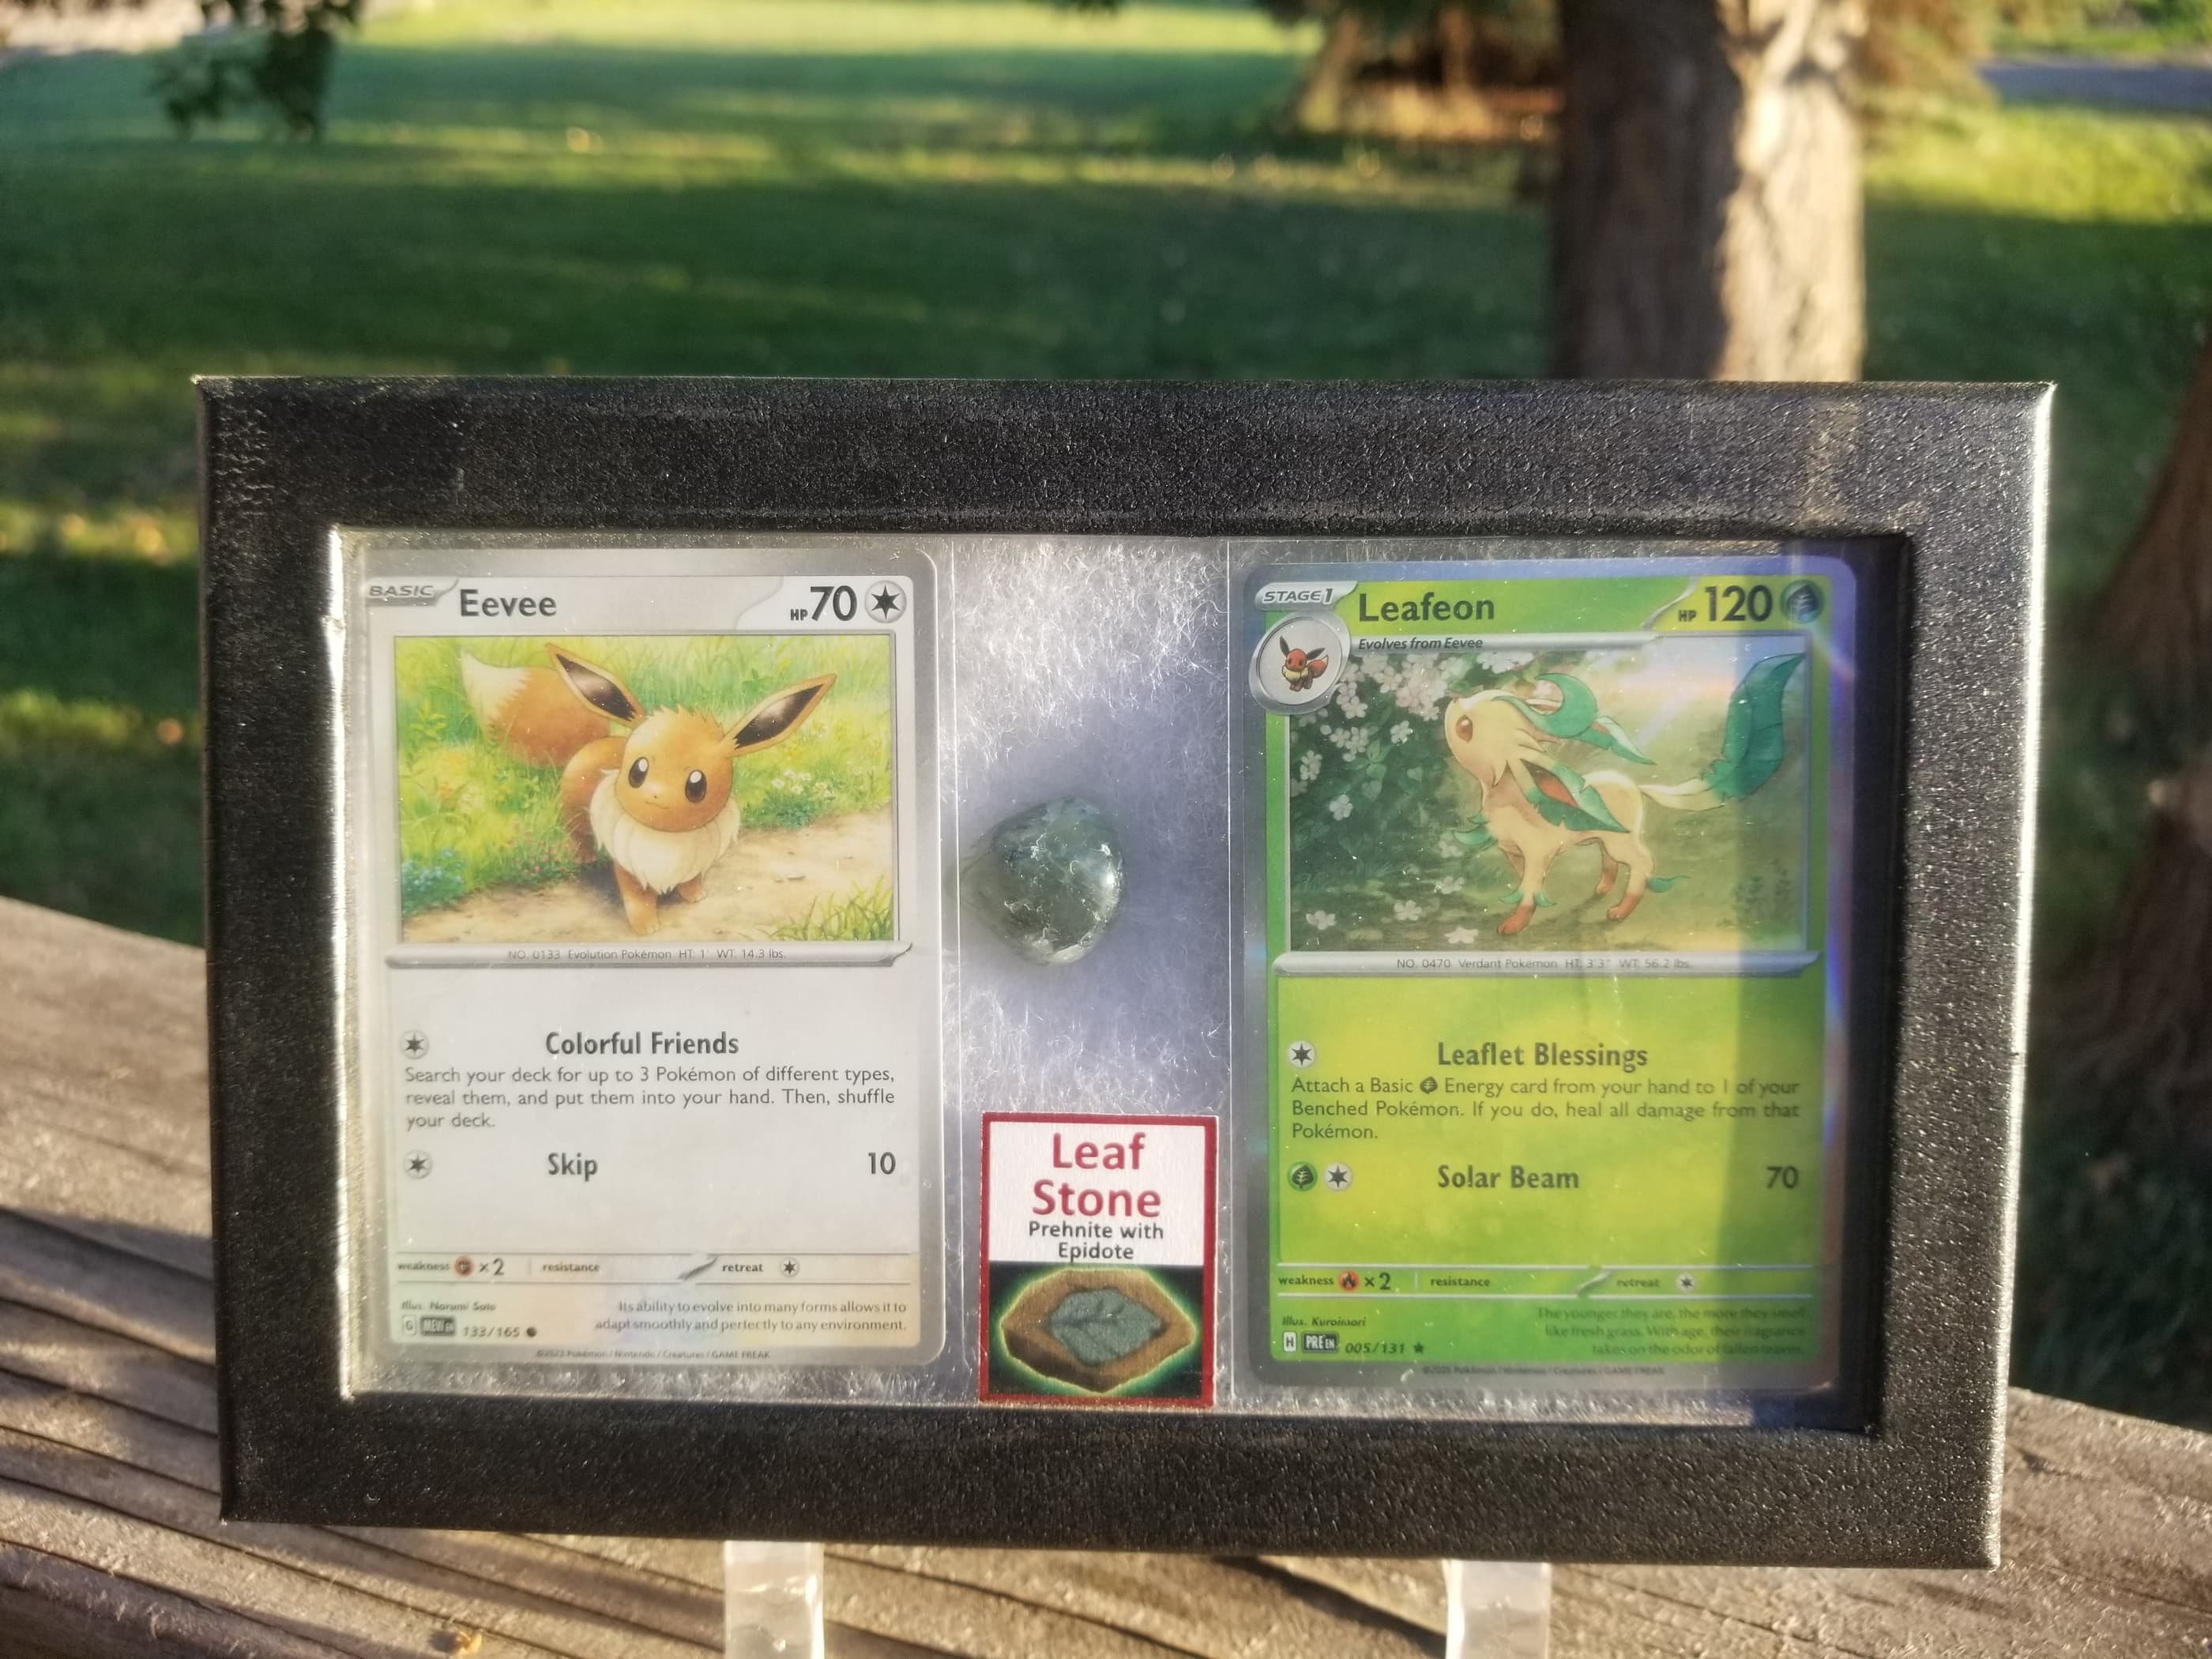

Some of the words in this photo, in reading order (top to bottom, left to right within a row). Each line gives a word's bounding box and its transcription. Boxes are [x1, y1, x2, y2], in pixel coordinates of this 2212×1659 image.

[369, 585, 434, 596] BASIC
[460, 589, 556, 617] Eevee
[791, 609, 808, 620] HP
[811, 585, 857, 621] 70
[1359, 592, 1494, 622] Leafeon
[1679, 611, 1697, 622] HP
[1705, 585, 1773, 622] 120
[1358, 638, 1407, 650] Evolves
[1410, 638, 1442, 649] from
[1444, 638, 1483, 649] Eevee
[532, 950, 561, 960] 0133
[568, 950, 617, 960] Evolution
[622, 949, 672, 960] Pokémon
[742, 950, 765, 959] 14.3
[769, 949, 786, 959] lbs.
[1423, 959, 1450, 969] 0470
[1459, 958, 1501, 969] Verdant
[546, 1031, 641, 1055] Colorful
[652, 1032, 739, 1055] Friends
[1438, 1042, 1524, 1066] Leaflet
[1535, 1042, 1648, 1073] Blessings
[405, 1066, 461, 1082] Search
[468, 1070, 506, 1087] your
[512, 1067, 551, 1082] deck
[558, 1067, 581, 1082] for
[589, 1070, 608, 1087] up
[616, 1070, 633, 1082] to
[641, 1067, 649, 1082] 3
[656, 1066, 735, 1082] Pokémon
[743, 1066, 760, 1082] of
[766, 1066, 839, 1082] different
[845, 1069, 894, 1085] types,
[1292, 1077, 1349, 1093] Attach
[1356, 1082, 1364, 1093] a
[1371, 1078, 1413, 1093] Basic
[1446, 1078, 1503, 1098] Energy
[1510, 1078, 1547, 1093] card
[1554, 1078, 1595, 1093] from
[1601, 1082, 1642, 1098] your
[1648, 1078, 1689, 1093] hand
[1697, 1081, 1714, 1093] to
[1736, 1078, 1754, 1093] of
[1760, 1082, 1800, 1098] your
[405, 1090, 455, 1105] reveal
[462, 1090, 510, 1107] them,
[517, 1090, 548, 1105] and
[555, 1092, 585, 1108] put
[591, 1090, 634, 1104] them
[642, 1089, 675, 1104] into
[683, 1093, 721, 1108] your
[730, 1089, 774, 1104] hand.
[782, 1089, 830, 1105] Then,
[837, 1089, 895, 1104] shuffle
[1292, 1100, 1368, 1115] Benched
[1376, 1100, 1464, 1116] Pokémon.
[1473, 1101, 1483, 1115] If
[1491, 1104, 1522, 1120] you
[1531, 1102, 1558, 1118] do,
[1567, 1102, 1602, 1117] heal
[1610, 1103, 1628, 1117] all
[1637, 1103, 1705, 1122] damage
[1713, 1102, 1755, 1117] from
[1763, 1102, 1800, 1117] that
[406, 1115, 445, 1132] your
[451, 1112, 495, 1128] deck.
[1292, 1123, 1378, 1138] Pokémon.
[1052, 1132, 1146, 1170] Leaf
[547, 1153, 597, 1183] Skip
[868, 1152, 896, 1175] 10
[1438, 1164, 1500, 1188] Solar
[1510, 1164, 1578, 1188] Beam
[1766, 1165, 1799, 1189] 70
[1032, 1179, 1161, 1218] Stone
[1029, 1221, 1112, 1240] Prehnite
[1121, 1222, 1164, 1240] with
[1059, 1242, 1134, 1263] Epidote
[397, 1262, 450, 1271] weakness
[543, 1263, 600, 1272] resistance
[722, 1263, 763, 1272] retreat
[1279, 1276, 1334, 1285] weakness
[619, 1301, 634, 1312] Its
[637, 1301, 675, 1315] ability
[678, 1303, 690, 1312] to
[692, 1301, 734, 1312] evolve
[737, 1302, 762, 1312] into
[765, 1304, 798, 1315] many
[801, 1301, 837, 1312] forms
[841, 1301, 880, 1312] allows
[882, 1301, 890, 1312] it
[893, 1303, 906, 1312] to
[595, 1319, 630, 1333] adapt
[633, 1319, 692, 1333] smoothly
[694, 1319, 718, 1330] and
[721, 1319, 777, 1333] perfectly
[781, 1321, 793, 1330] to
[796, 1322, 817, 1333] any
[821, 1320, 906, 1330] environment.
[1286, 1336, 1294, 1348] H
[1345, 1343, 1405, 1353] 005/131
